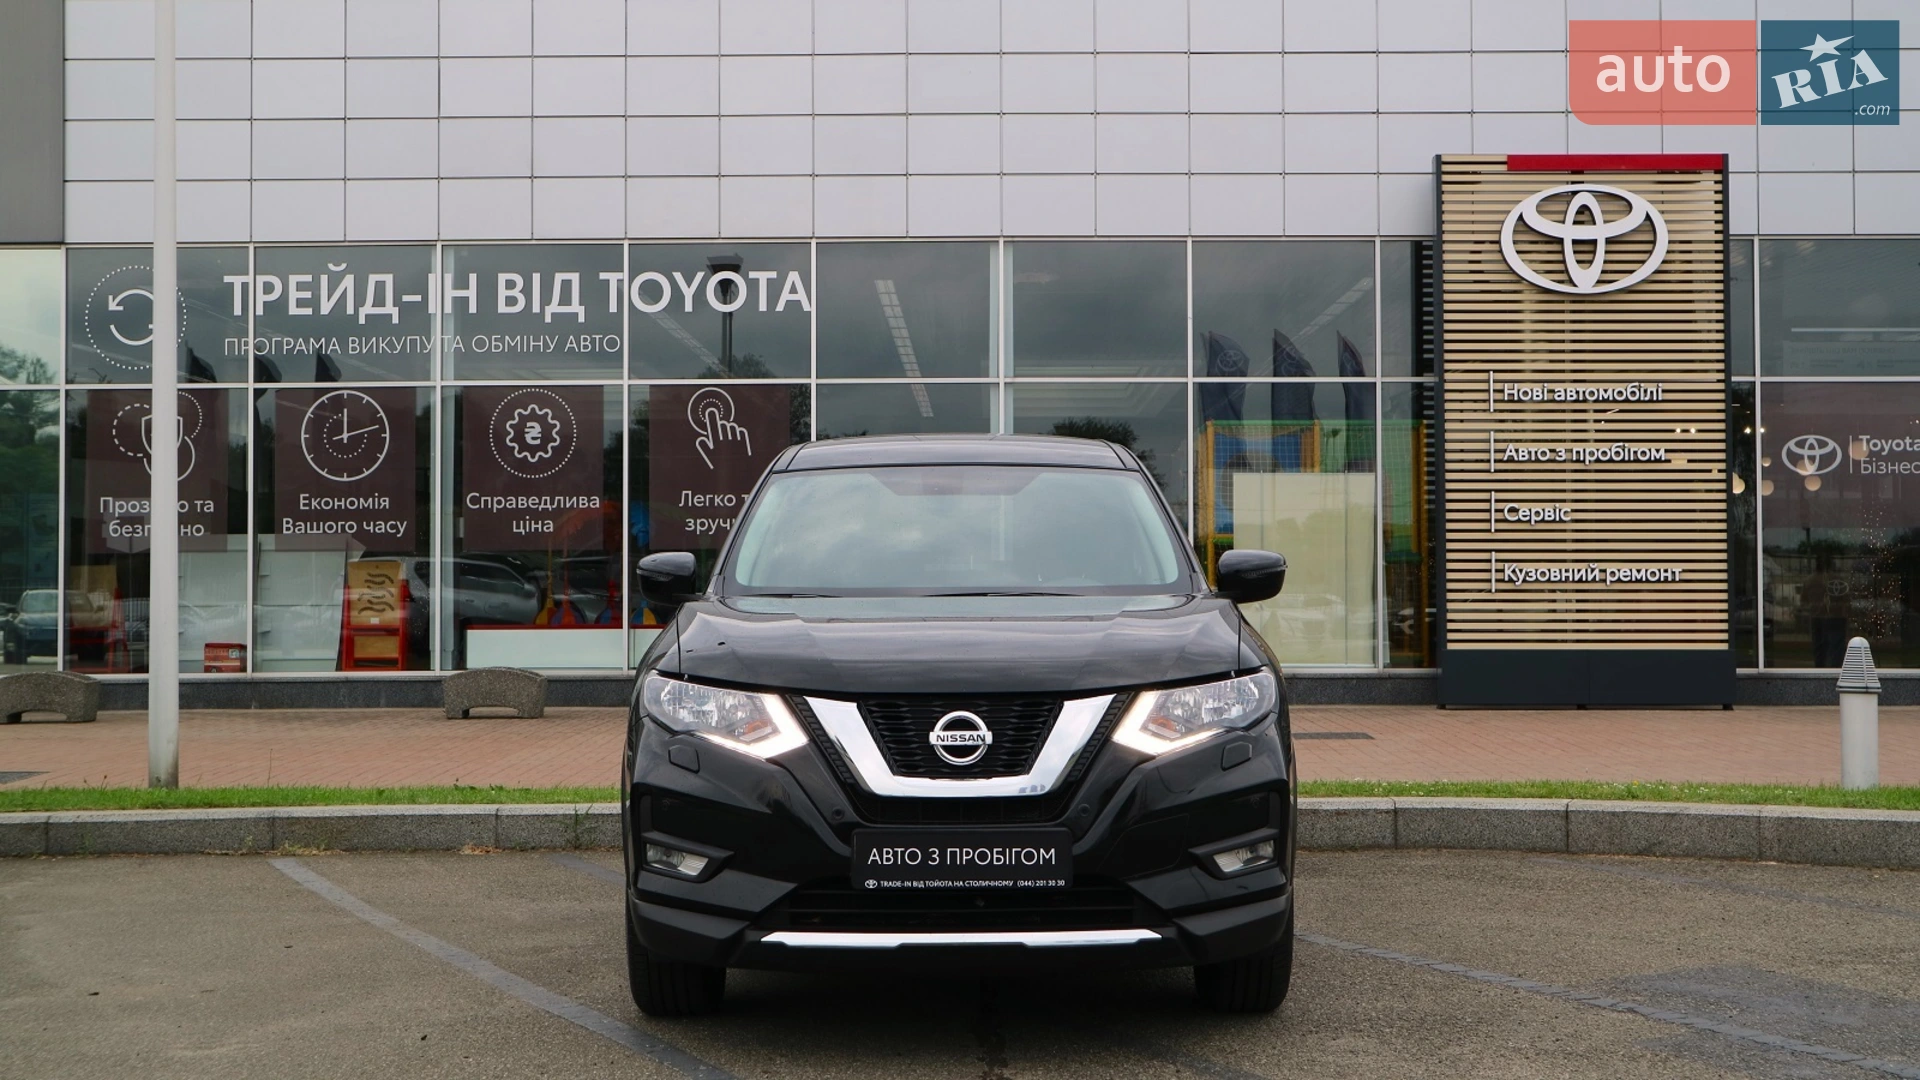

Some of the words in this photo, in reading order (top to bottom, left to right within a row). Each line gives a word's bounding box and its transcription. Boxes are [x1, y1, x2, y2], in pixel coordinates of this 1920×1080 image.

[223, 262, 477, 325] ТРЕЙД-ІН
[497, 272, 585, 323] ВІД
[599, 270, 811, 313] TOYOTA
[224, 337, 341, 356] ПРОГРАМА
[348, 336, 435, 354] ВИКУПУ
[441, 335, 465, 353] ТА
[472, 334, 559, 353] ОБМІНУ
[564, 334, 621, 353] АВТО
[1503, 383, 1549, 401] Нові
[1553, 382, 1663, 401] автомобілі
[1503, 444, 1550, 461] Авто
[1555, 447, 1567, 461] з
[1572, 443, 1666, 465] пробігом
[1858, 435, 1920, 455] Toyota
[1860, 457, 1920, 474] Бізнес
[100, 497, 189, 517] Прозо
[194, 500, 215, 513] та
[300, 494, 390, 510] Економія
[466, 492, 600, 511] Справедлива
[678, 490, 737, 507] Легко
[1503, 504, 1572, 525] Сервіс
[282, 518, 357, 535] Вашого
[363, 521, 408, 537] часу
[513, 516, 554, 534] ціна
[685, 518, 736, 535] зруч
[1503, 563, 1600, 585] Кузовний
[1606, 568, 1683, 586] ремонт
[936, 733, 987, 743] NISSAN
[867, 847, 922, 865] АВТО
[946, 847, 1056, 865] ПРОБІГОМ
[880, 879, 912, 888] TRADE-IN
[1017, 879, 1035, 888] (044)
